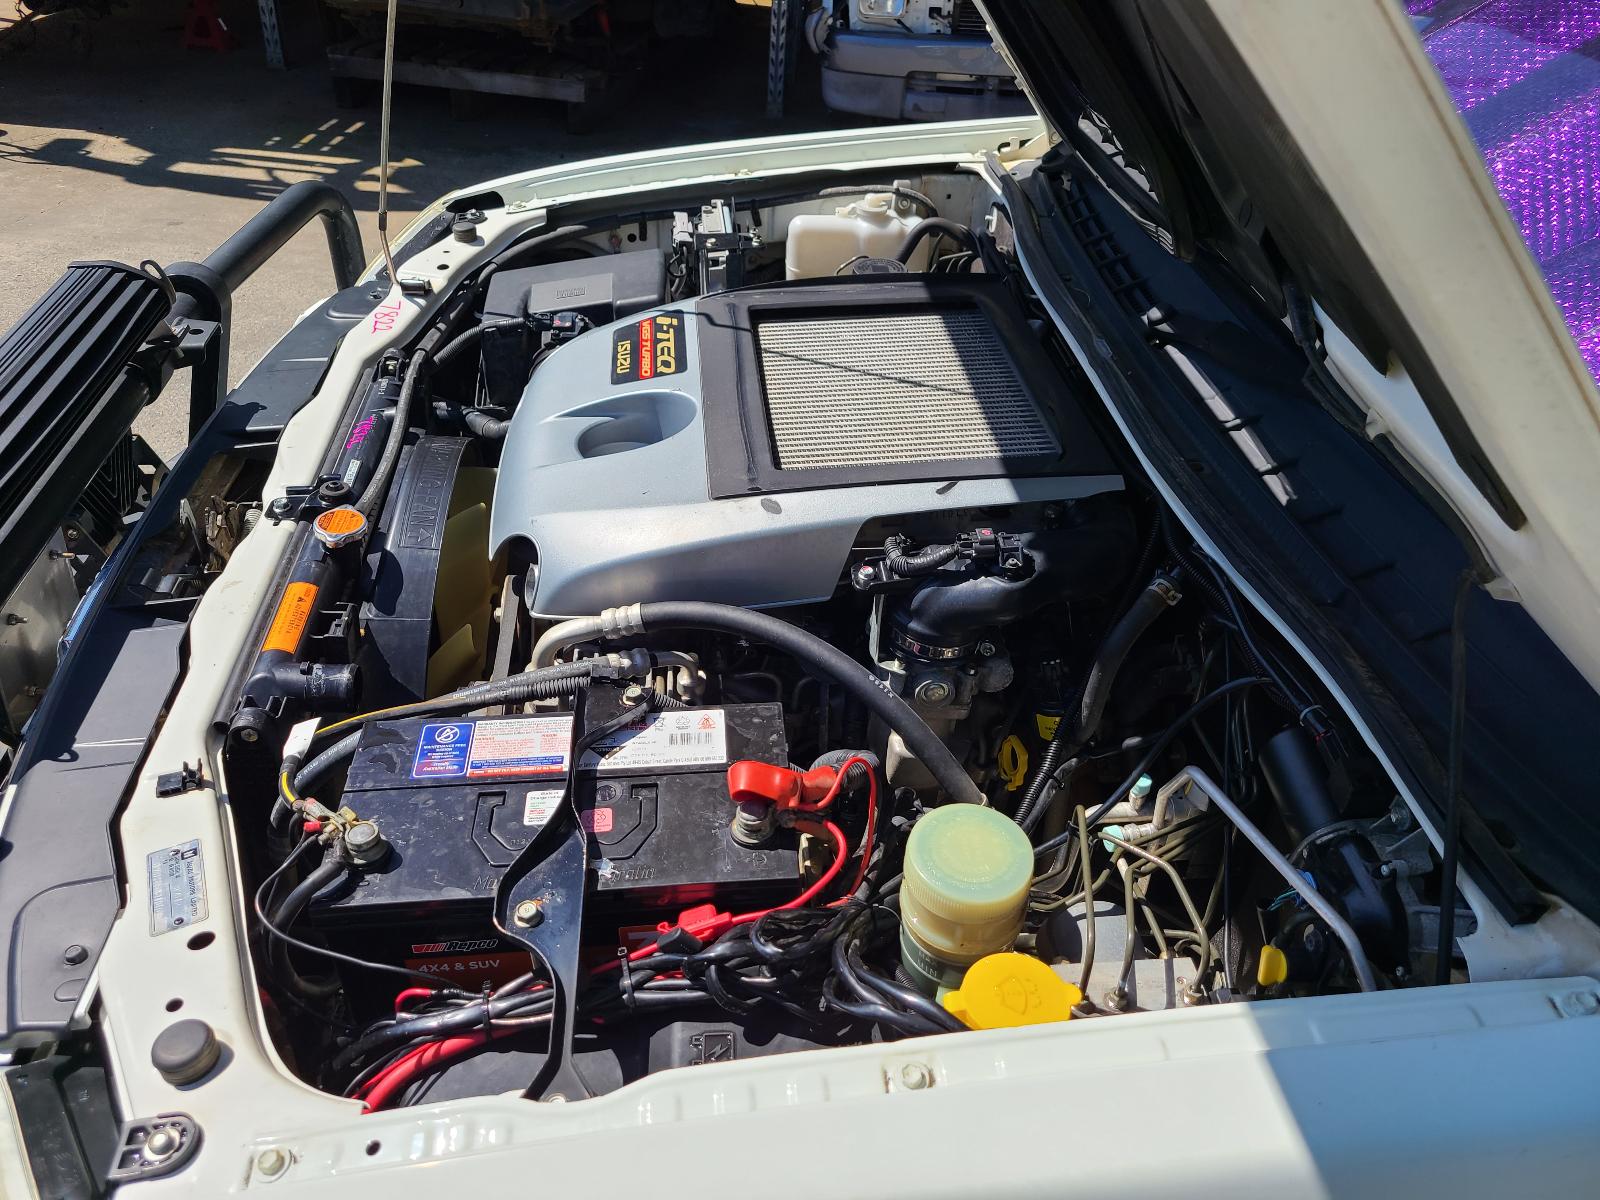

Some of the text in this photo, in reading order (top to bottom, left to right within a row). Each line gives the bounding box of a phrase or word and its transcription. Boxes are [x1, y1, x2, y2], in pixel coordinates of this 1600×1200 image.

[371, 301, 402, 334] 7822
[616, 340, 631, 374] ISUZU
[641, 340, 651, 377] TURBO
[656, 316, 678, 374] i-TEQ
[445, 939, 499, 952] Repco
[418, 959, 500, 973] 4X4 & SUV
